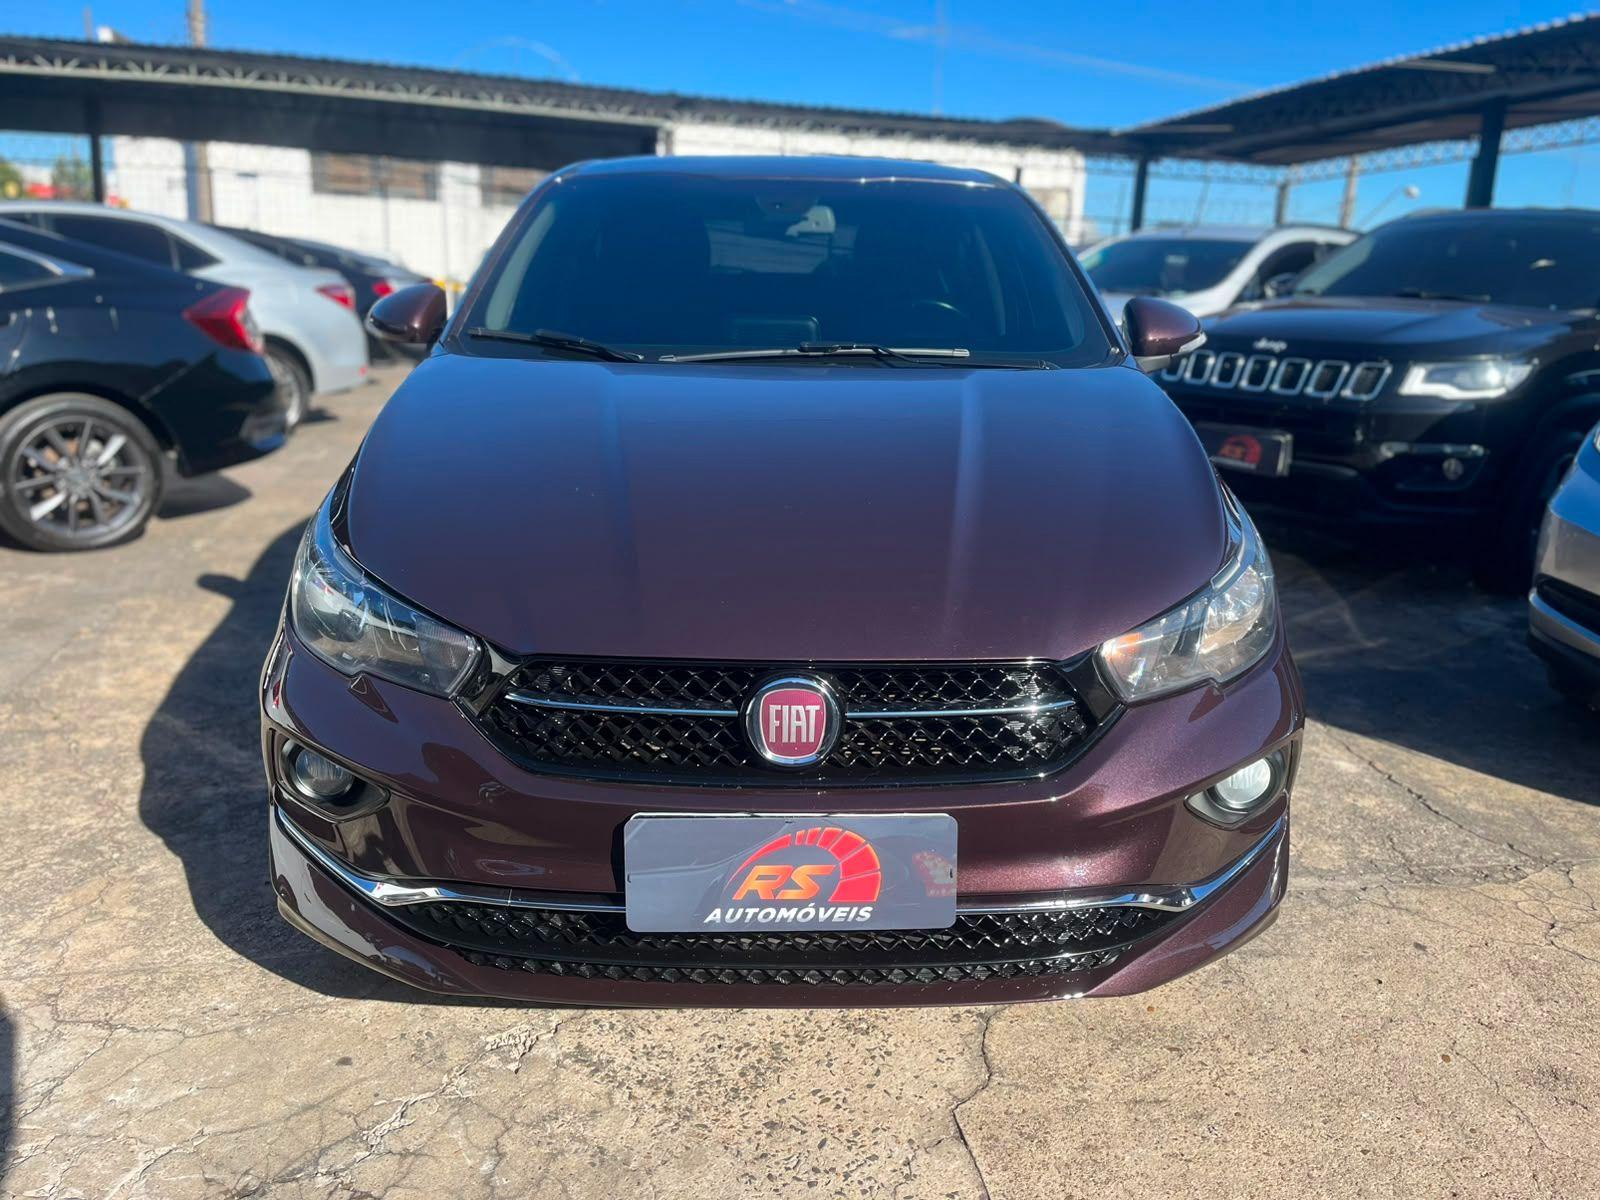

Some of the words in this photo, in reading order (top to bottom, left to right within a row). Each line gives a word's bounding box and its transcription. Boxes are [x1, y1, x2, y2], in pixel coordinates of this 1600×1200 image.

[770, 704, 820, 743] FIAT
[733, 865, 836, 900] RS
[704, 904, 873, 923] AUTOMÓVEIS
